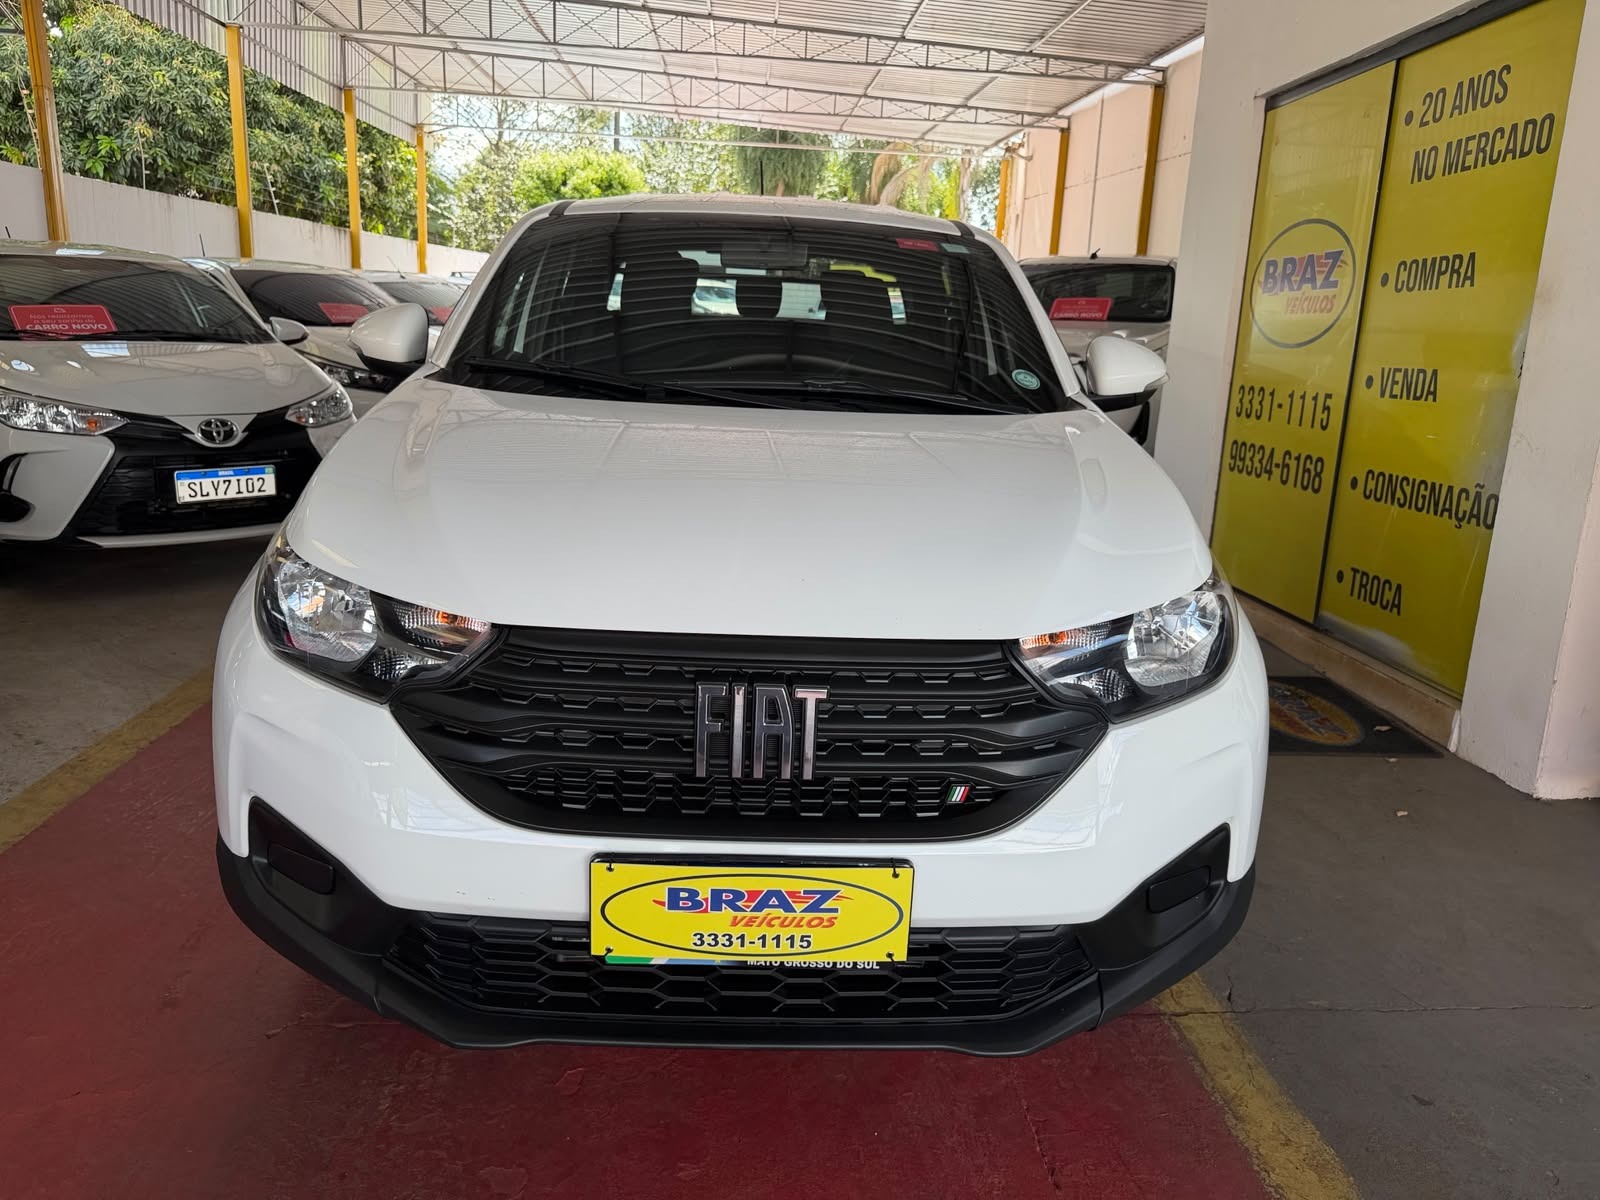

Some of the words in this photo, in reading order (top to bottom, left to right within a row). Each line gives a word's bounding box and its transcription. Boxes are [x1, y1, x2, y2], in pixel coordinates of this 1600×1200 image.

[1419, 87, 1447, 128] 20
[1449, 64, 1511, 118] ANOS
[1410, 145, 1439, 184] NO
[1442, 113, 1555, 177] MERCADO
[1262, 250, 1344, 294] BRAZ
[1394, 252, 1476, 293] COMPRA
[1284, 292, 1336, 314] VEÍCULOS
[1379, 367, 1438, 403] VENDA
[1235, 384, 1333, 432] 3331-1115
[187, 477, 266, 498] SLY7I02
[1228, 439, 1325, 495] 99334-6168
[1362, 468, 1500, 530] CONSIGNAÇÃO
[1349, 567, 1403, 617] TROCA
[695, 682, 830, 781] FIAT
[666, 887, 842, 914] BRAZ
[729, 913, 838, 929] VEÍCULOS
[692, 932, 813, 949] 3331-1115
[836, 961, 853, 969] DO
[856, 961, 880, 969] SUL
